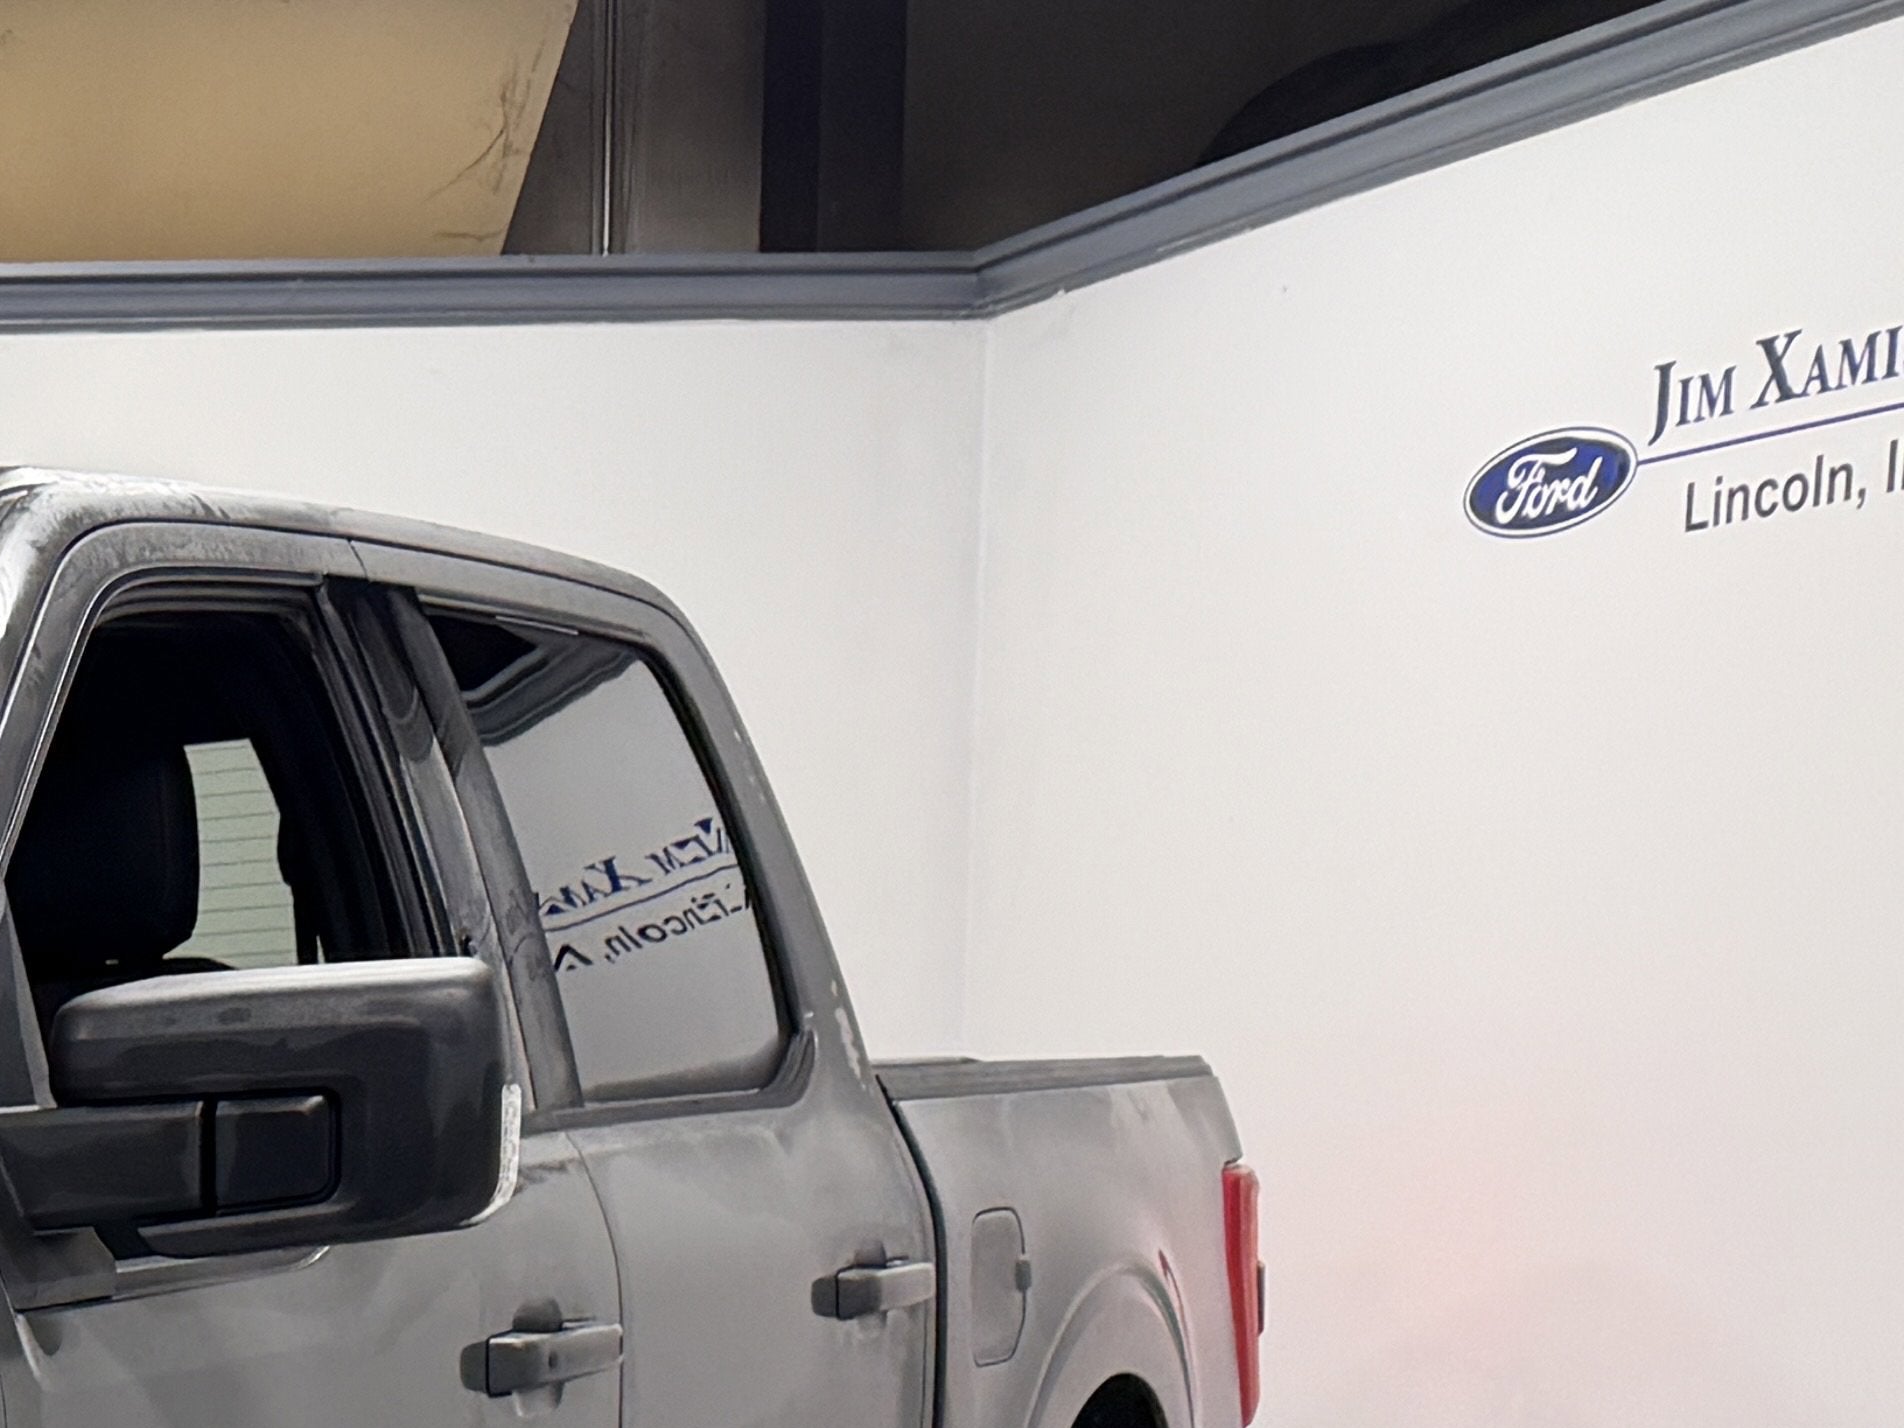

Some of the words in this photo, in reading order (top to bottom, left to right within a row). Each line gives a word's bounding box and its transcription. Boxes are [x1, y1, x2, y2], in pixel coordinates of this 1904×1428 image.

[1648, 361, 1737, 446] JIM
[1750, 325, 1904, 410] XAMI
[1496, 447, 1603, 524] Ford
[1684, 455, 1868, 533] Lincoln,
